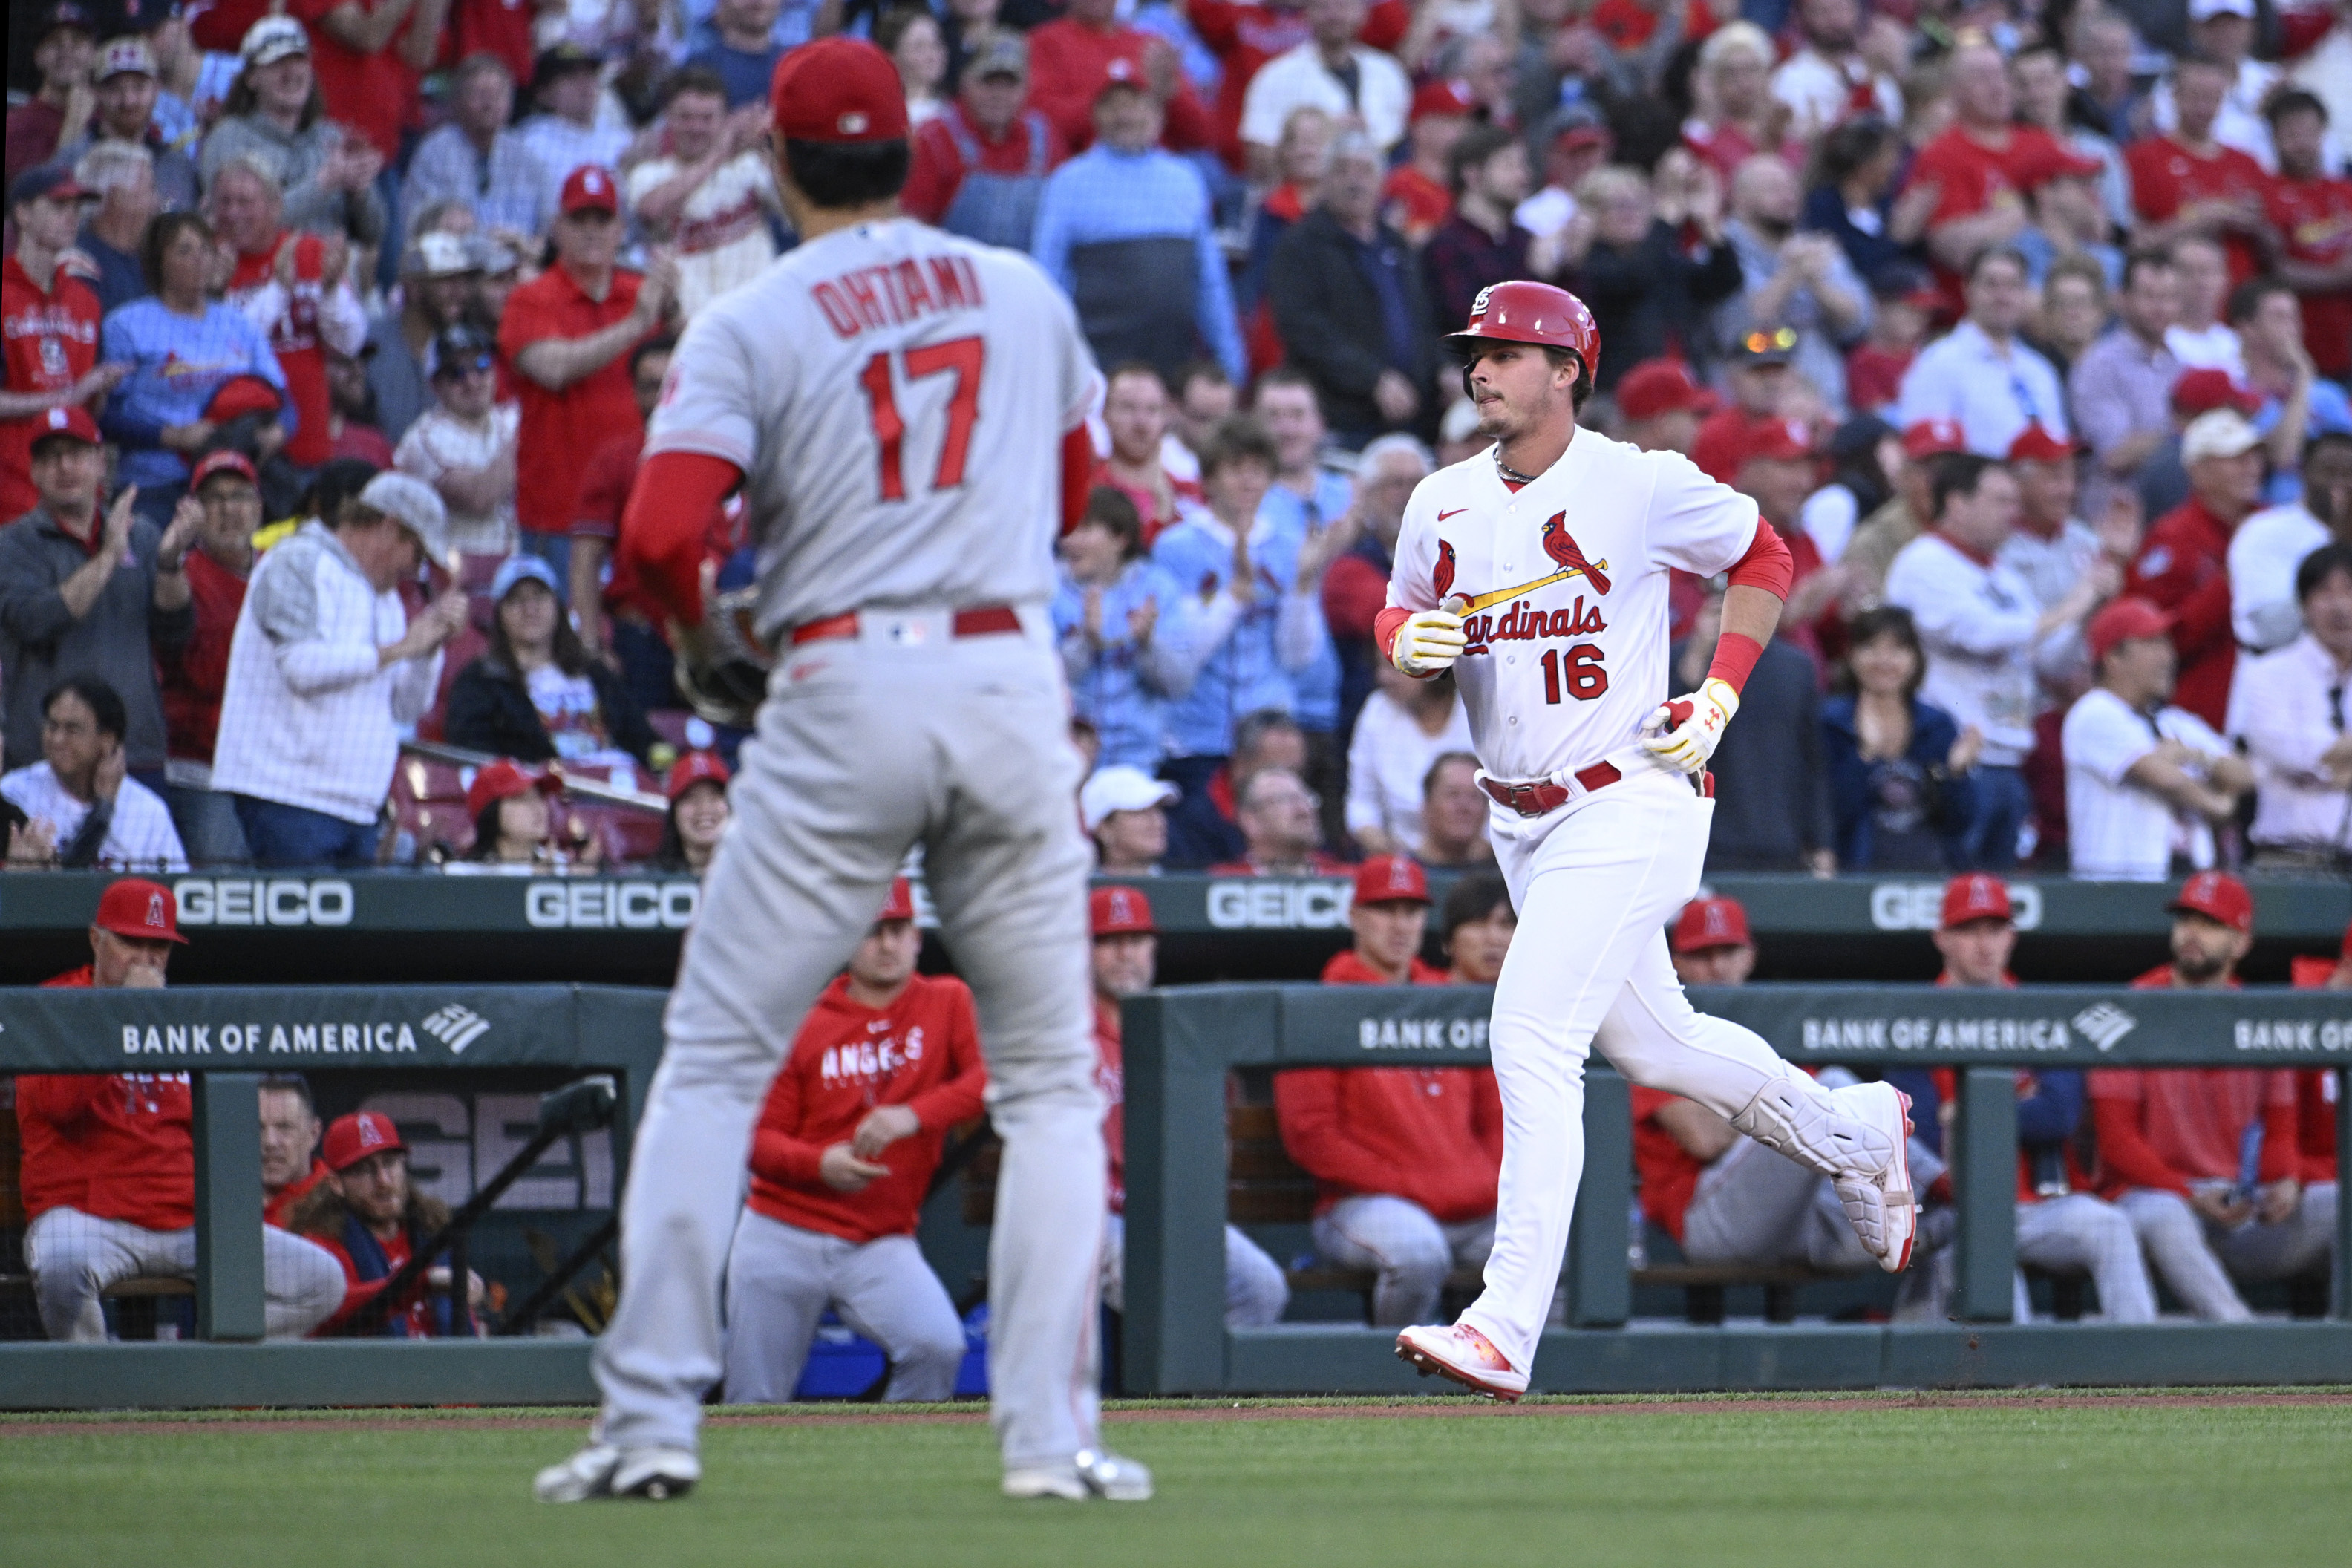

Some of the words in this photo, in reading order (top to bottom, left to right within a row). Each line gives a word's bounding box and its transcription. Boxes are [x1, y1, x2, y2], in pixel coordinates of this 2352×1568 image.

[811, 256, 984, 339] OHTANI
[858, 333, 985, 503] 17
[1541, 644, 1609, 705] 16
[173, 879, 354, 926] GEICO
[526, 882, 701, 928] GEICO
[122, 1024, 212, 1054] BANK
[220, 1025, 261, 1054] OF
[268, 1022, 417, 1054] AMERICA
[1359, 1018, 1446, 1050] BANK
[1802, 1018, 1888, 1051] BANK
[1891, 1017, 1931, 1051] OF
[1934, 1018, 2071, 1051] AMERICA
[2235, 1019, 2316, 1051] BANK
